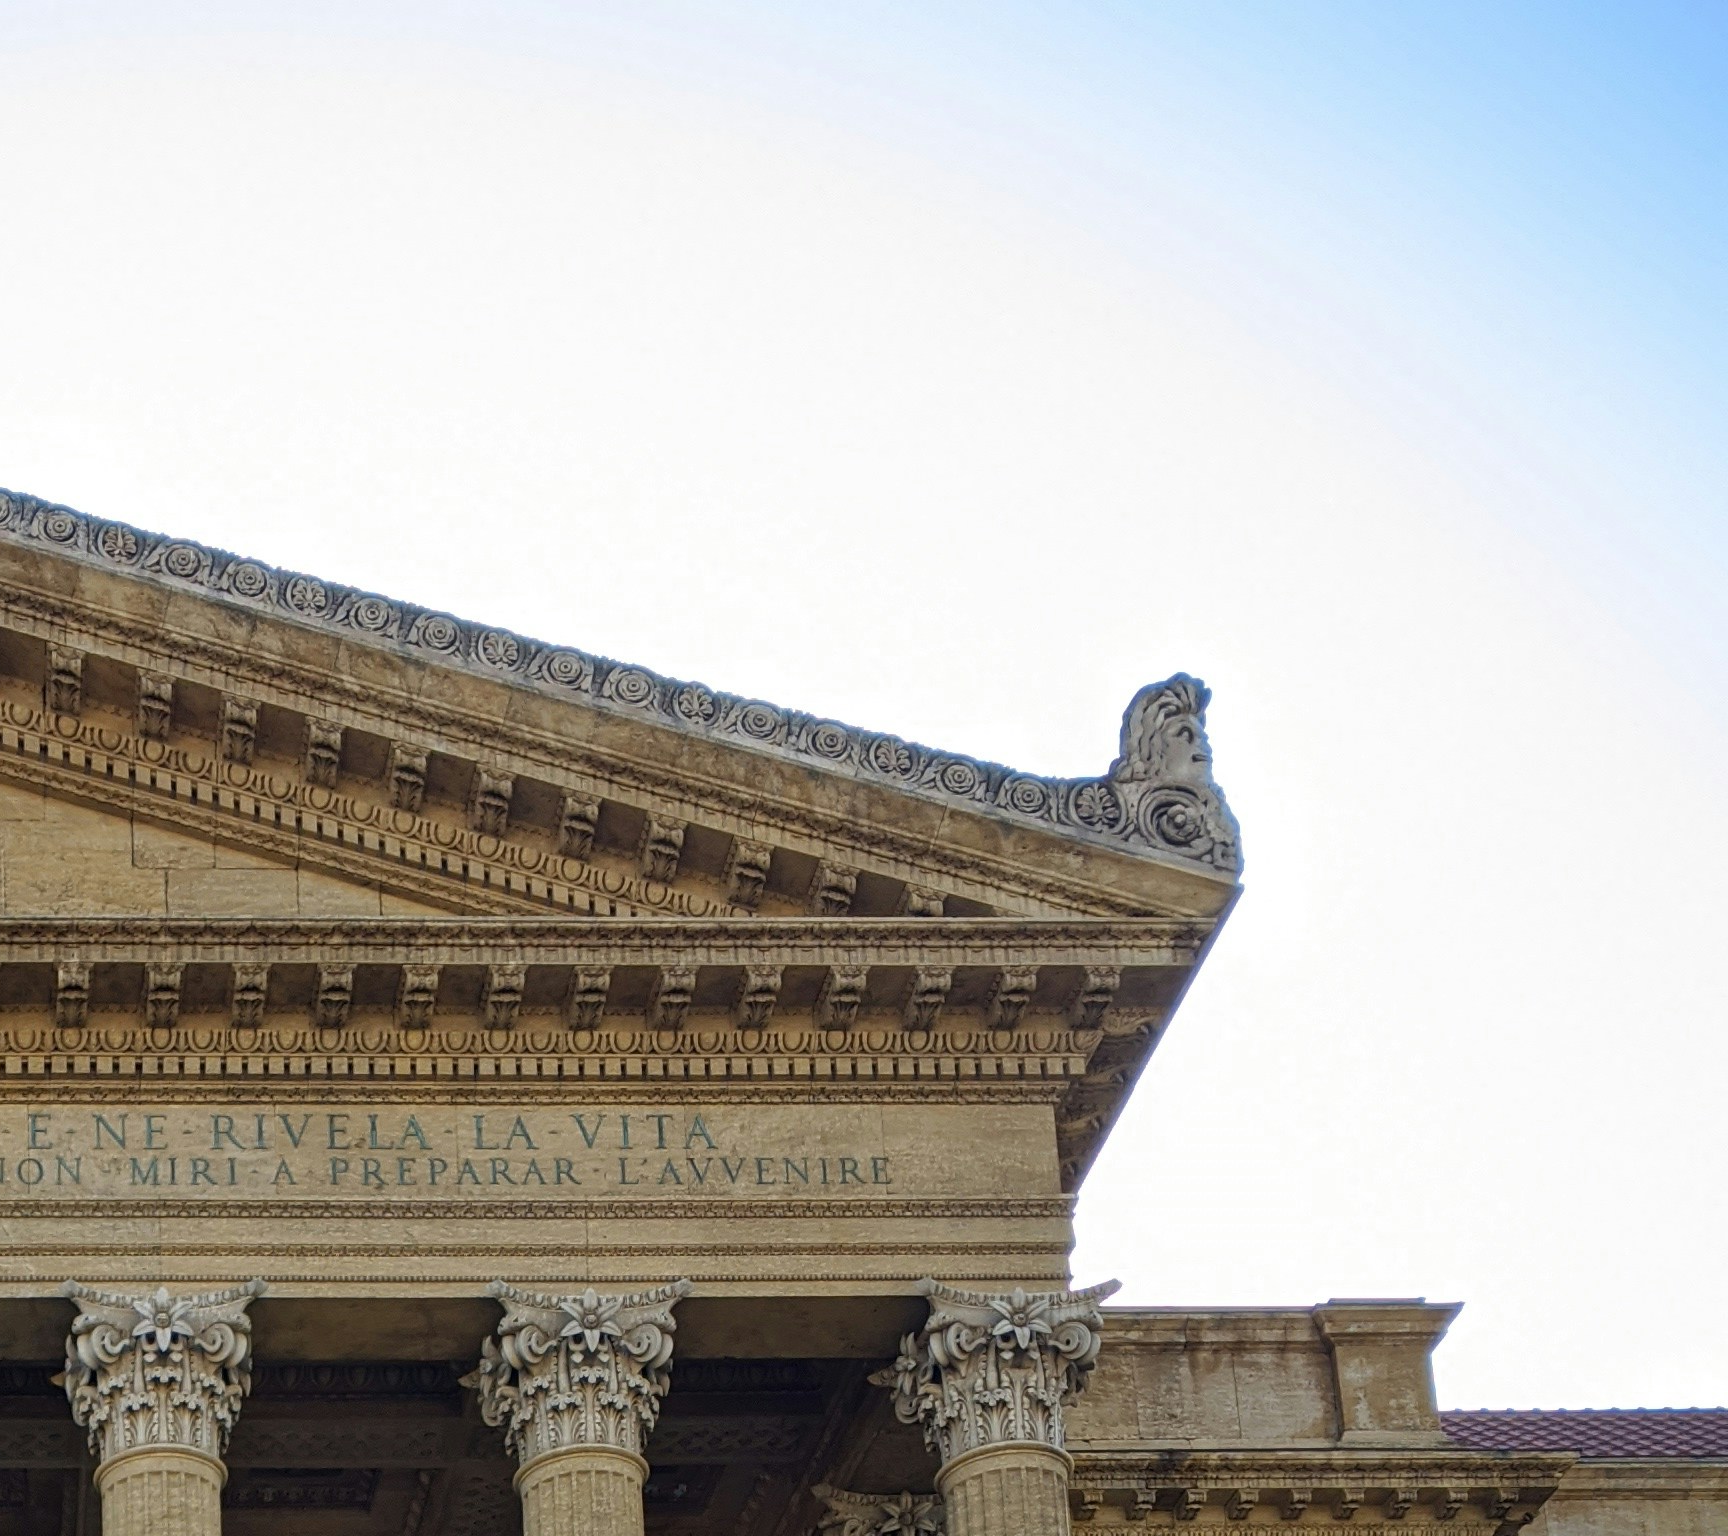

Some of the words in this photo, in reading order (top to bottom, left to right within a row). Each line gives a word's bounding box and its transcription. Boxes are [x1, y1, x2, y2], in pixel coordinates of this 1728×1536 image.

[27, 1113, 54, 1150] E
[92, 1113, 168, 1150] NE
[210, 1113, 432, 1151] RIVELA
[473, 1113, 540, 1151] LA
[570, 1113, 718, 1151] VITA
[129, 1156, 239, 1186] MIRI
[270, 1156, 299, 1186] A
[329, 1156, 582, 1187] PREPARAR
[618, 1156, 893, 1186] L'AVVENIRE
